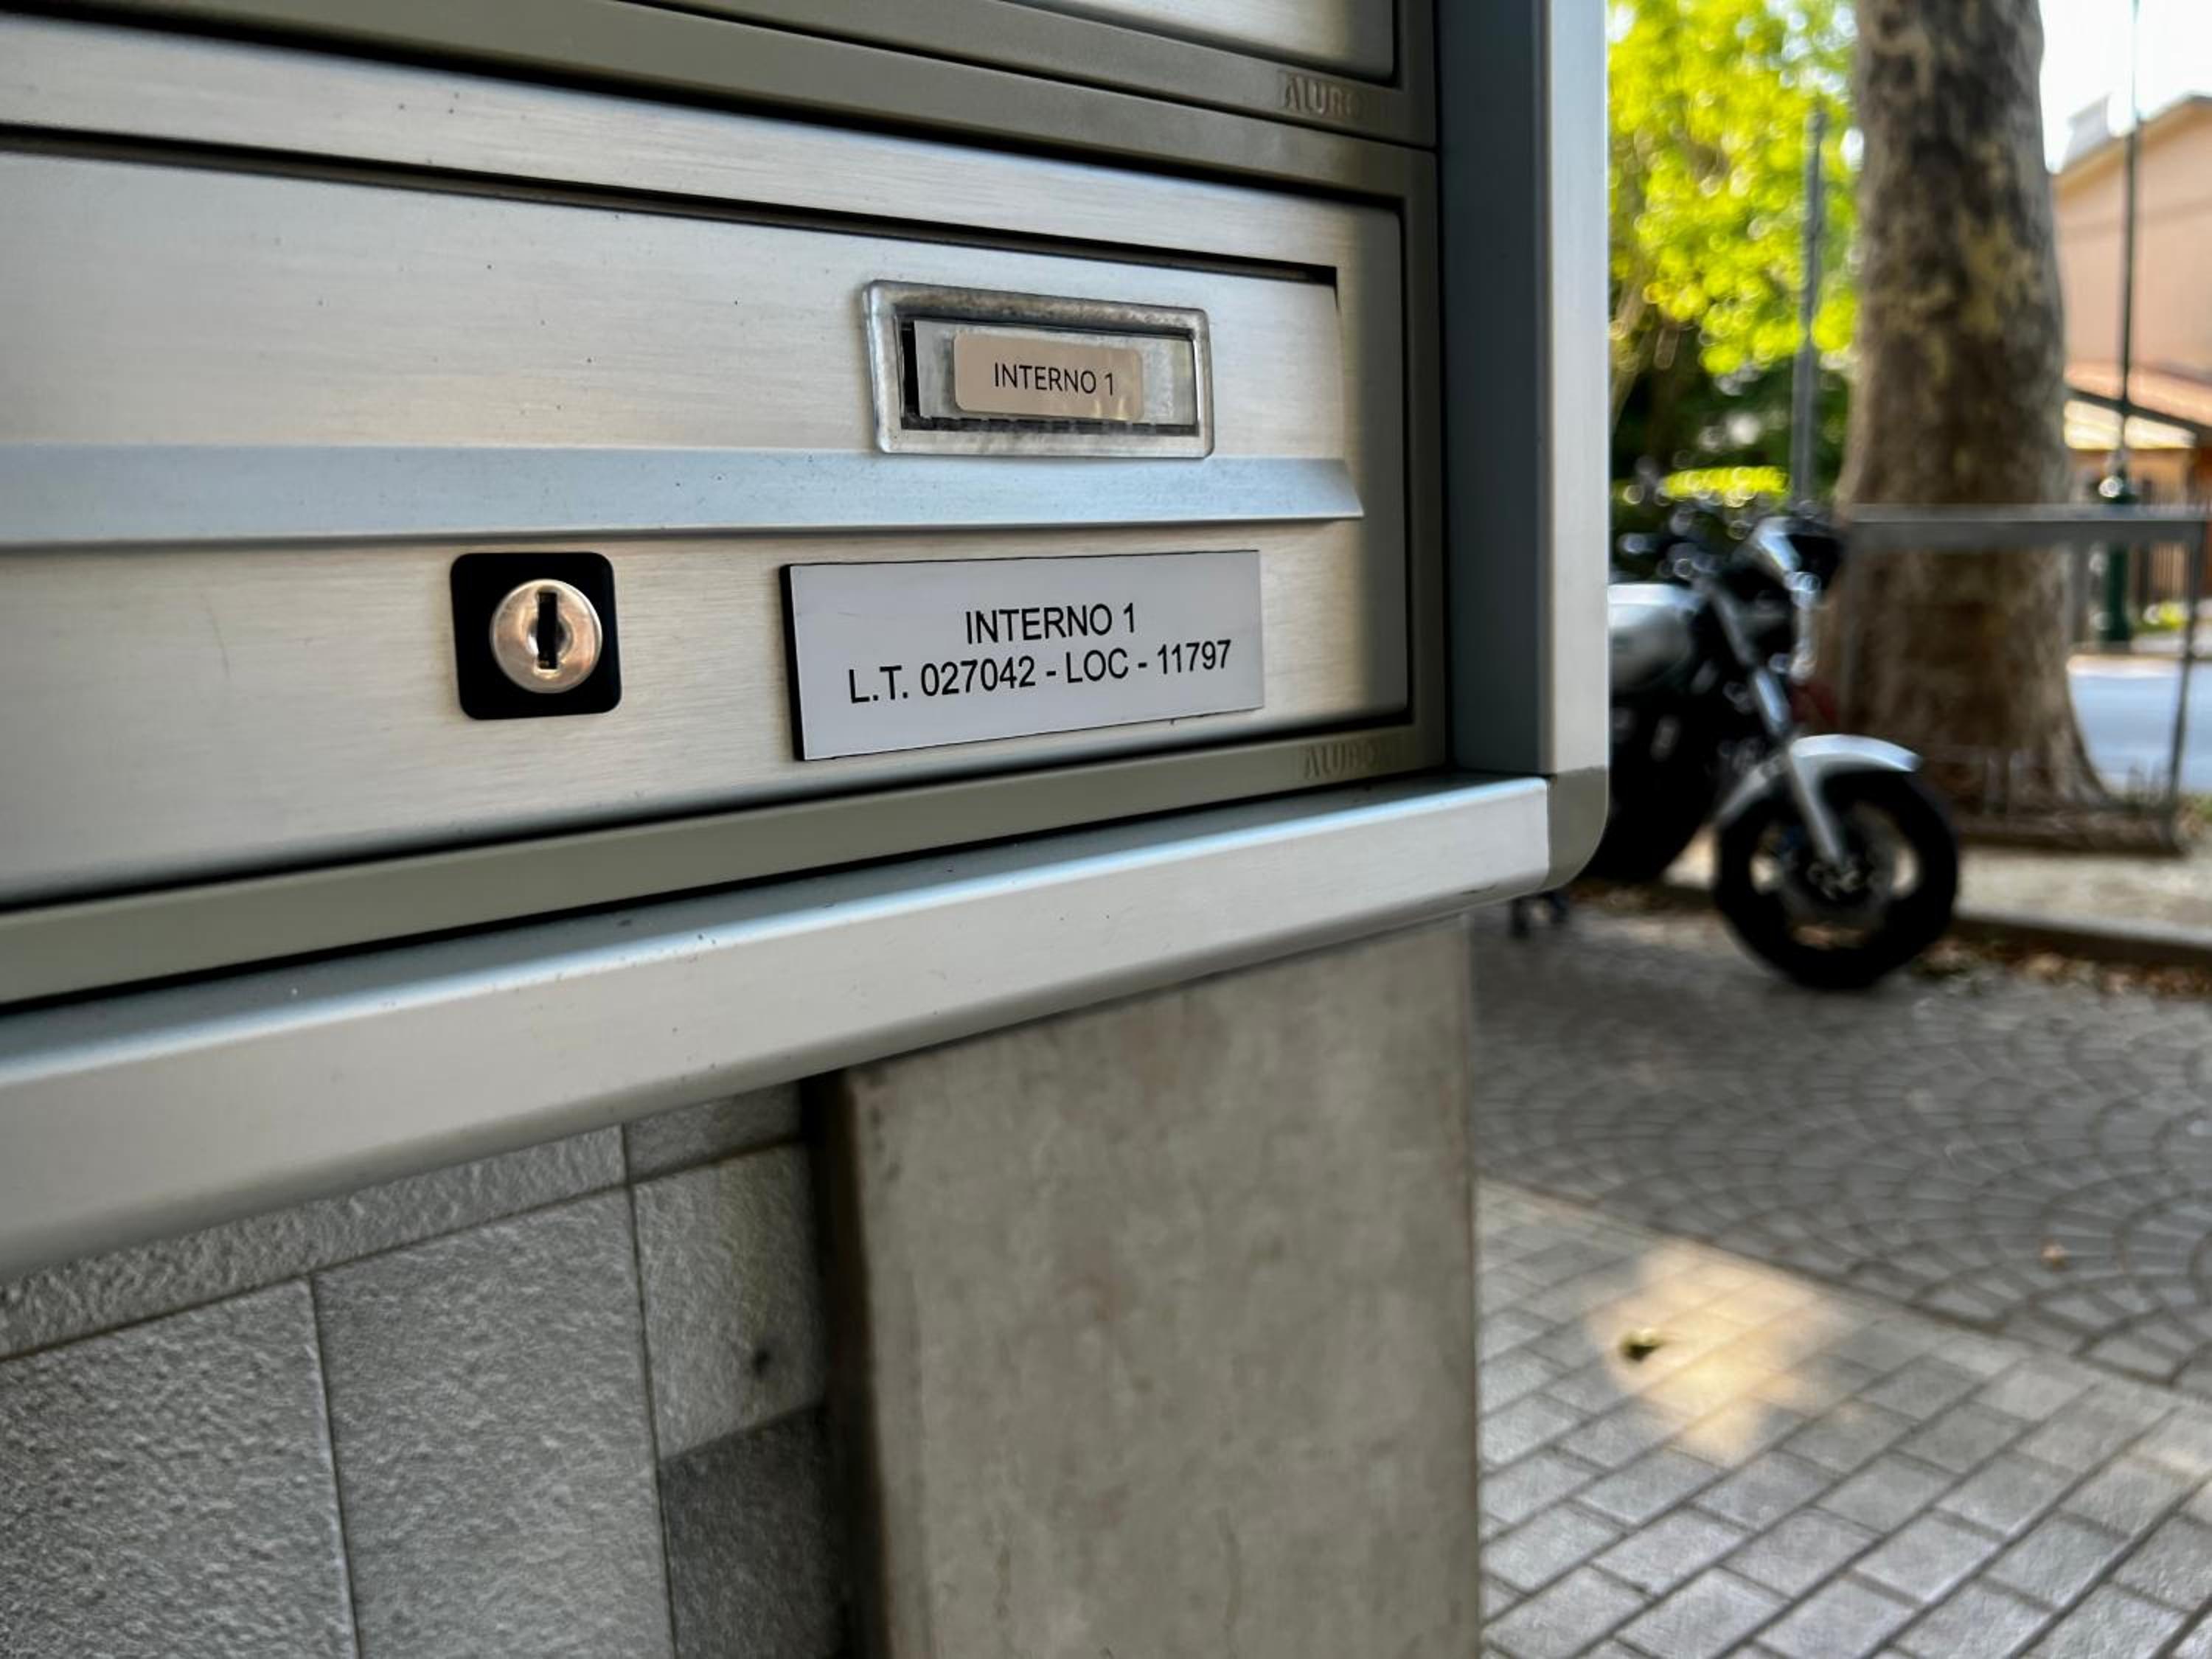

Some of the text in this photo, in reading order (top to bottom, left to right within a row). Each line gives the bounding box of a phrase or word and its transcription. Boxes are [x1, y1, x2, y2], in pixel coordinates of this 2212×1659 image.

[994, 362, 1114, 396] INTERNO 1
[965, 602, 1135, 645] INTERNO 1
[849, 665, 908, 704] L.T.
[920, 656, 1036, 697] 027042
[1065, 647, 1129, 684] LOC
[1157, 639, 1232, 675] 11797
